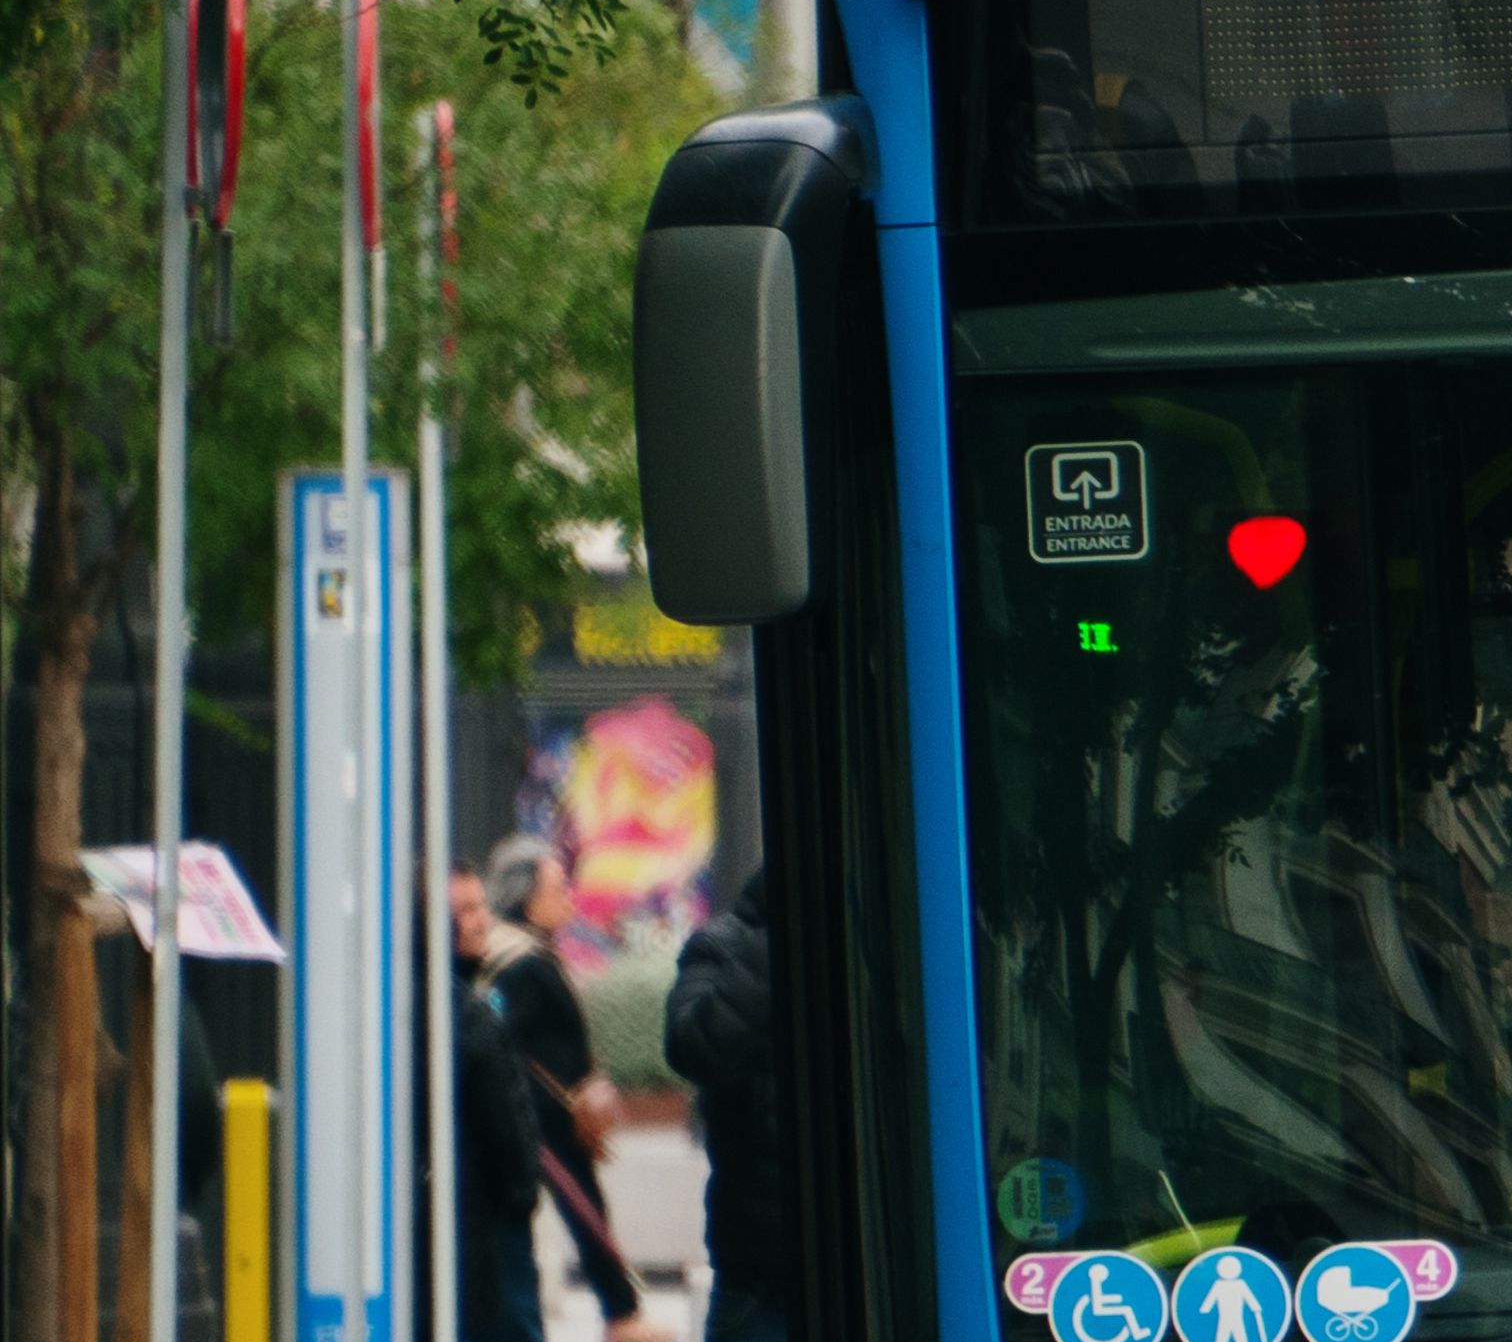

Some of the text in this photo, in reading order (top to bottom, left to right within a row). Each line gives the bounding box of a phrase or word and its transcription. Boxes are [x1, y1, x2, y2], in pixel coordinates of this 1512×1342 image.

[1044, 513, 1132, 532] ENTRADA
[1046, 535, 1131, 552] ENTRANCE
[1416, 1249, 1441, 1281] 4
[1021, 1262, 1045, 1294] 2
